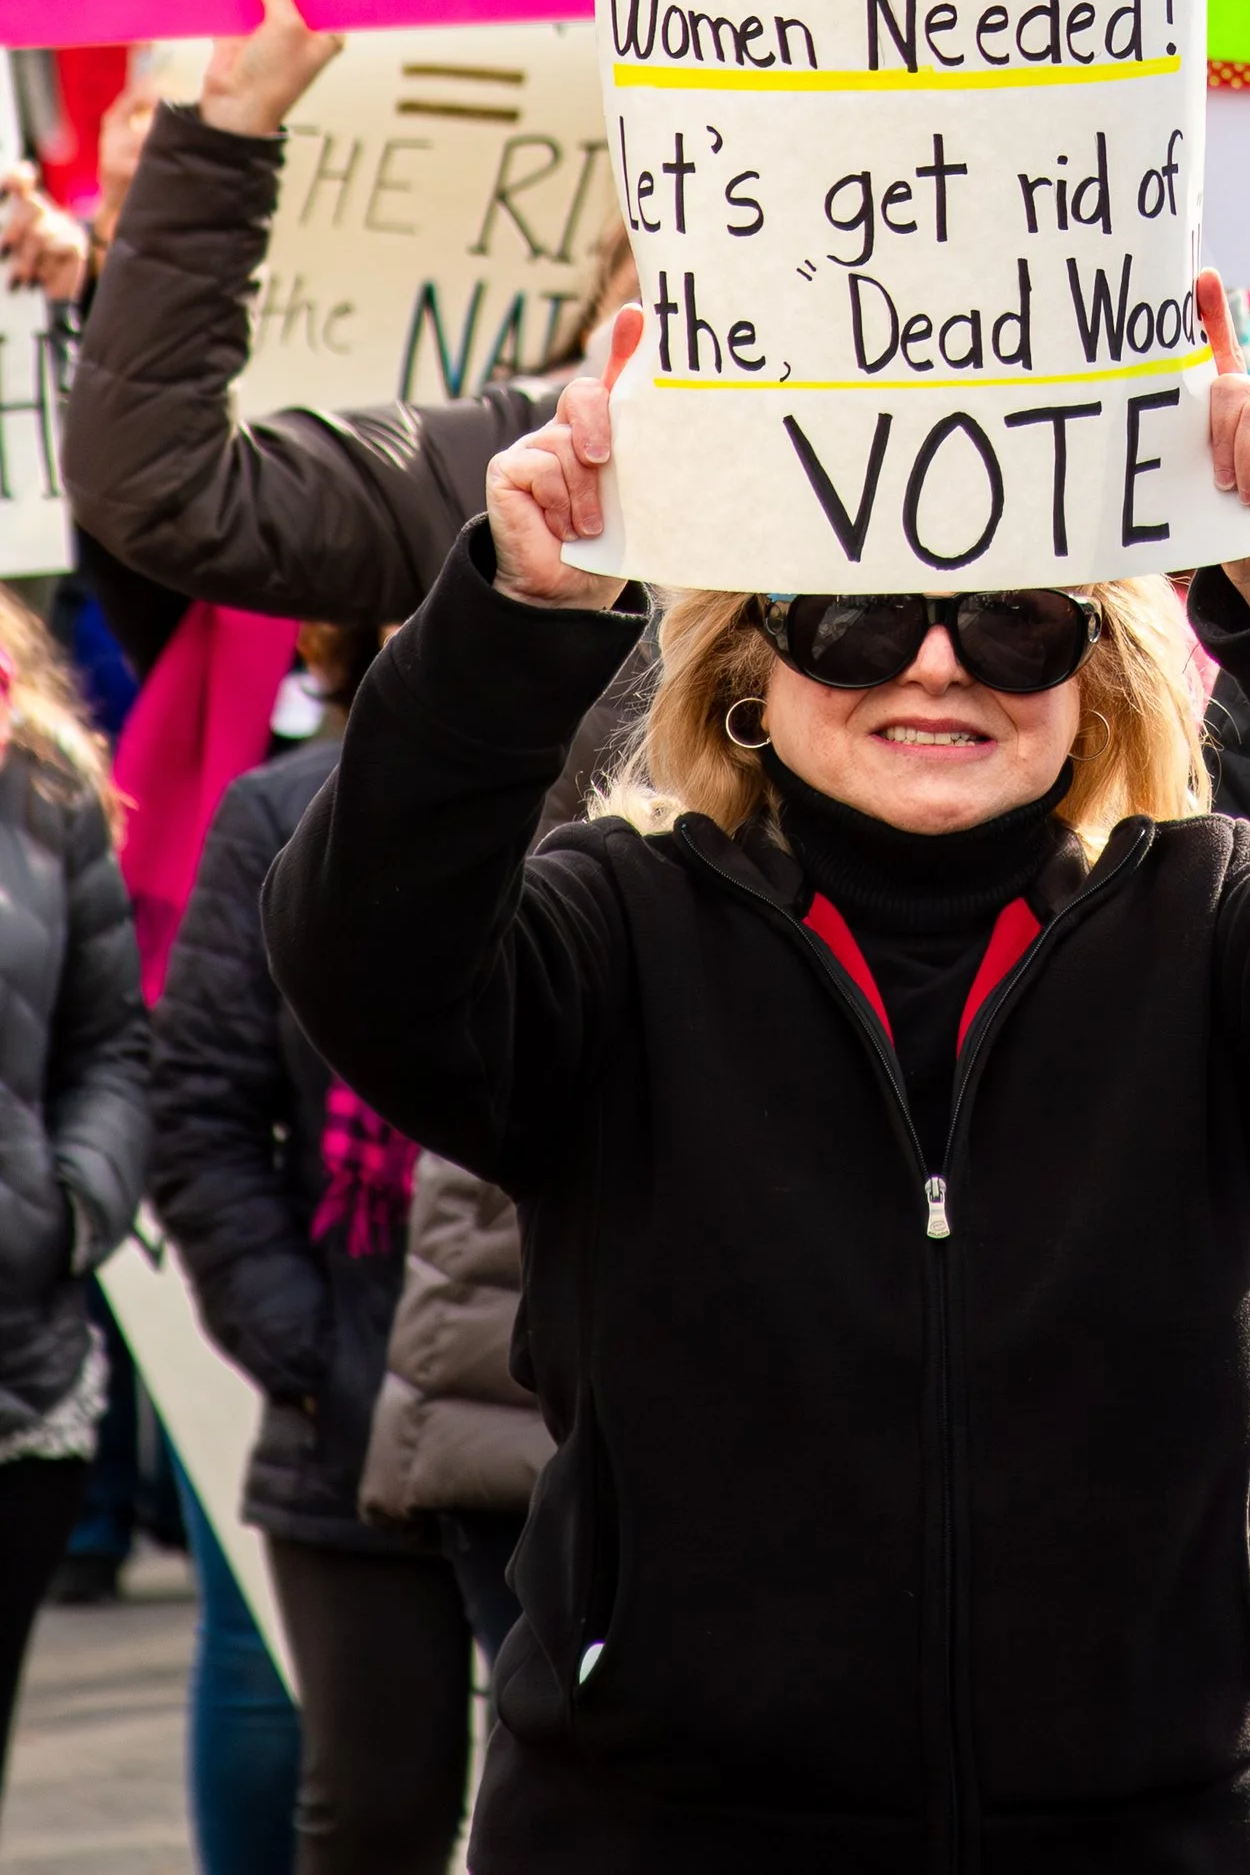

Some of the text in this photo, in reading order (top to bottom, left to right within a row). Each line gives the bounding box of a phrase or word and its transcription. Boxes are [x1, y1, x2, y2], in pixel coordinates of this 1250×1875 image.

[825, 133, 968, 267] get
[1017, 131, 1113, 235] rid
[1137, 129, 1184, 219] of
[783, 388, 1181, 571] VOTE
